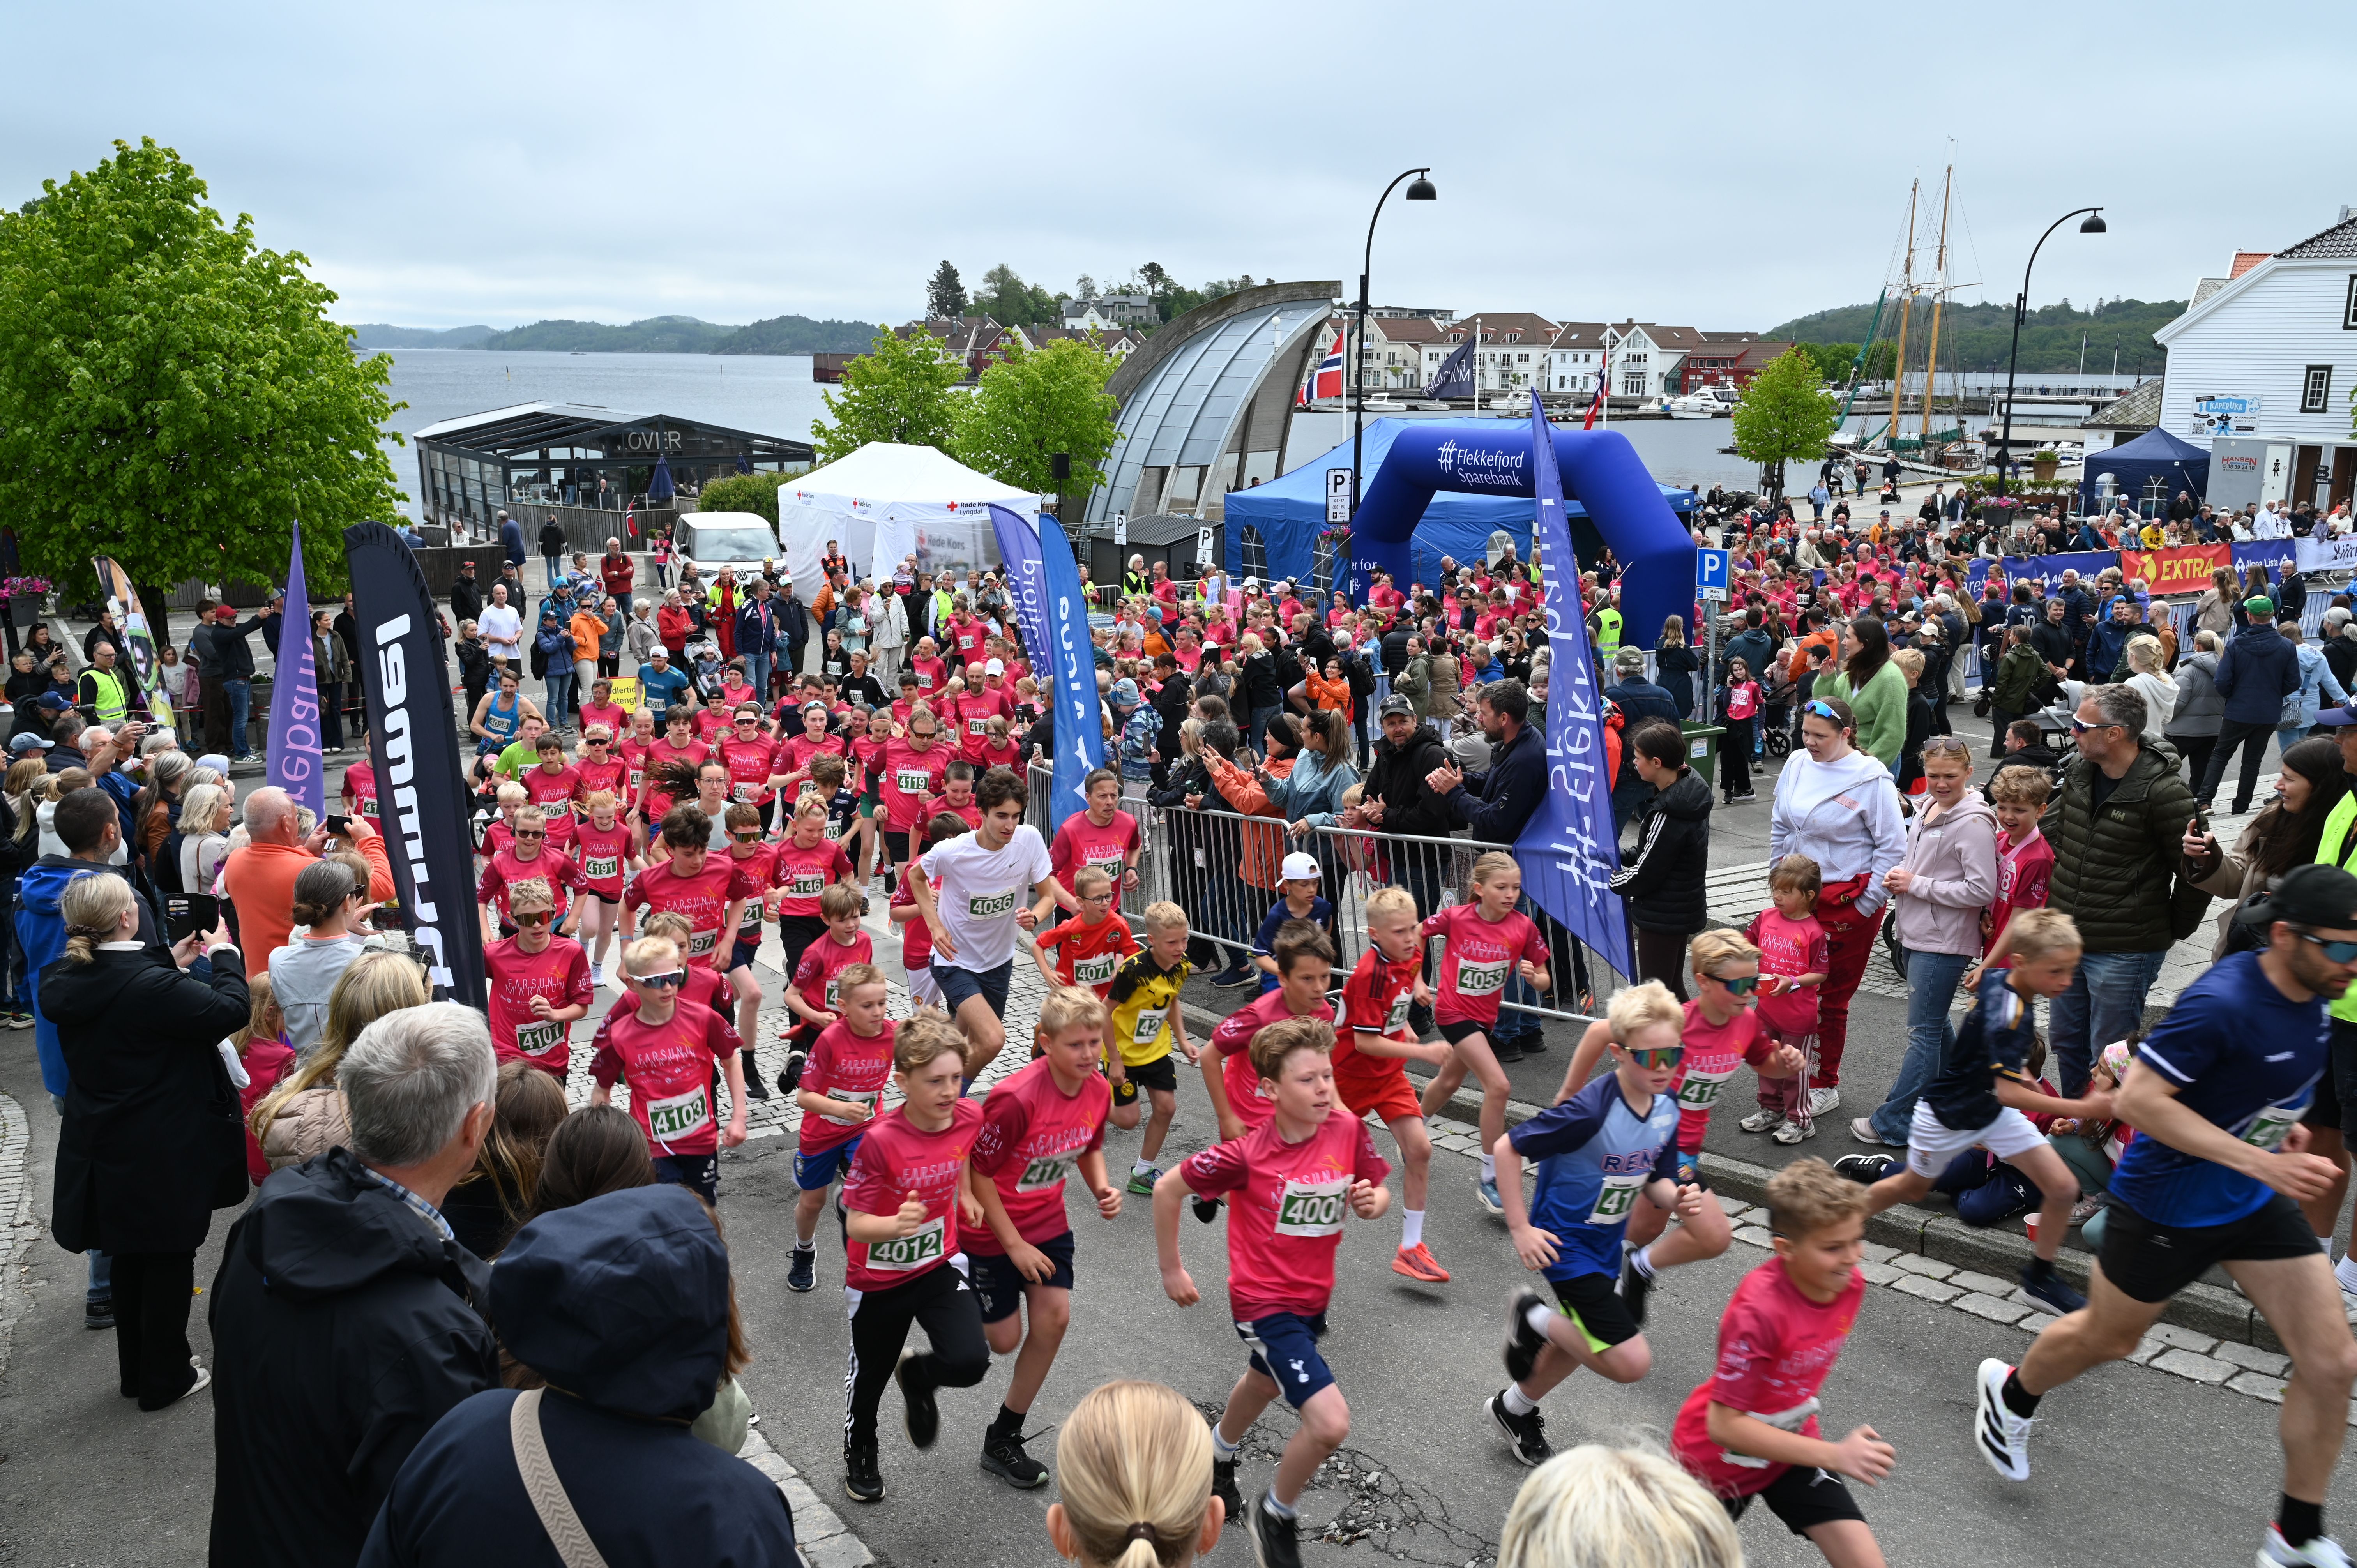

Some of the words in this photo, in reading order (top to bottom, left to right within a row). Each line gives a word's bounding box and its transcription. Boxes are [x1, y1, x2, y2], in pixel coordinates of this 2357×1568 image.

[2210, 401, 2242, 411] KAPERUKA
[1457, 448, 1524, 470] Flekkefjord
[2222, 456, 2257, 466] HANSEN
[1334, 475, 1345, 493] P
[1458, 468, 1523, 487] Sparebank
[1117, 518, 1124, 533] P
[1200, 531, 1210, 549] P
[1703, 554, 1720, 582] P
[2161, 558, 2215, 581] EXTRA
[2263, 558, 2278, 567] Lista
[827, 664, 841, 673] 4092
[648, 701, 664, 710] 4016
[490, 717, 510, 731] 4058
[970, 723, 985, 732] 412
[899, 776, 926, 789] 4119
[542, 803, 567, 816] 4079
[2110, 809, 2126, 821] HH
[587, 862, 614, 875] 4191
[790, 880, 822, 894] 4146
[973, 897, 1012, 915] 4036
[689, 936, 713, 953] 097
[1761, 938, 1800, 958] MARATON
[1763, 932, 1799, 950] FARSUND
[1078, 959, 1111, 980] 4071
[508, 976, 562, 989] FARSUND
[1461, 968, 1505, 988] 4053
[505, 981, 564, 996] MARATON
[1579, 993, 1588, 1007] HOKA
[523, 1024, 561, 1049] 4101
[654, 1103, 673, 1111] hummel
[655, 1099, 703, 1132] 4103
[875, 1232, 937, 1263] 4012
